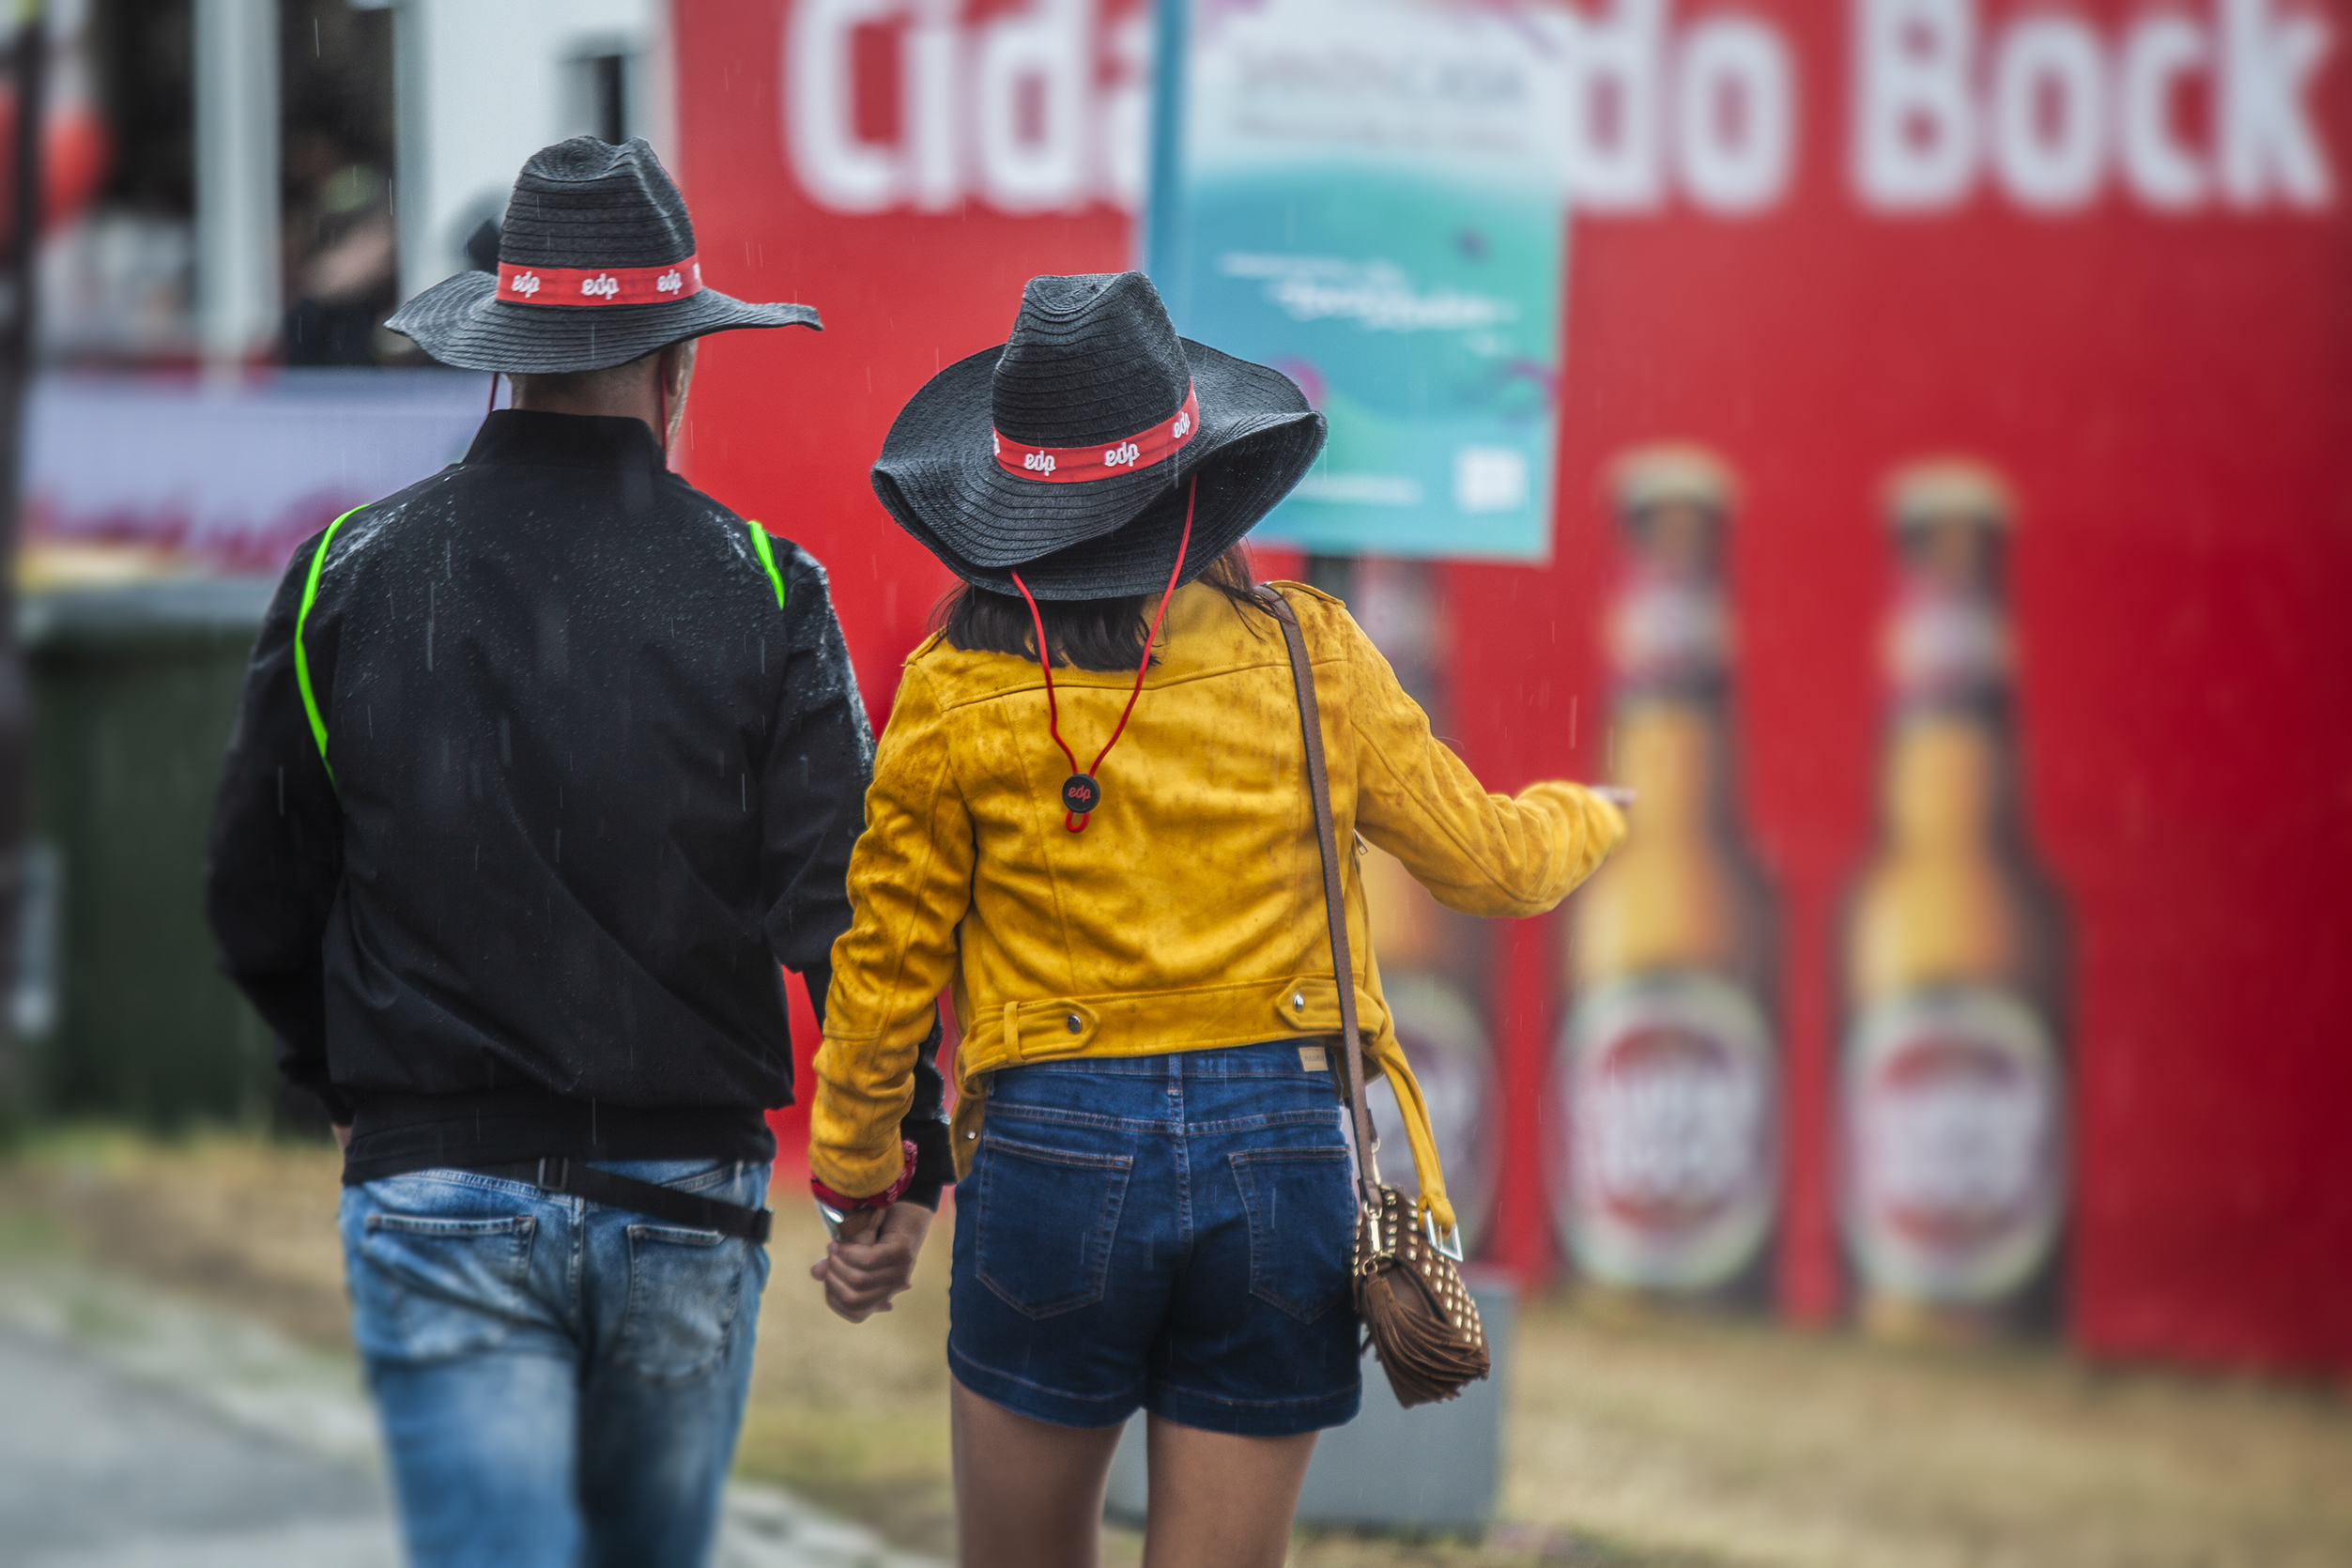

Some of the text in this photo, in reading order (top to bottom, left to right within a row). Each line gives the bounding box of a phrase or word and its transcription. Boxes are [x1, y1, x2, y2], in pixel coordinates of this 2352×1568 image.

[1566, 0, 1793, 214] do
[1850, 0, 2336, 214] Bock
[512, 271, 541, 298] edp
[580, 273, 619, 300] edp
[657, 269, 683, 295] edp
[1023, 412, 1191, 476] edp edp edp
[1068, 785, 1091, 803] edp
